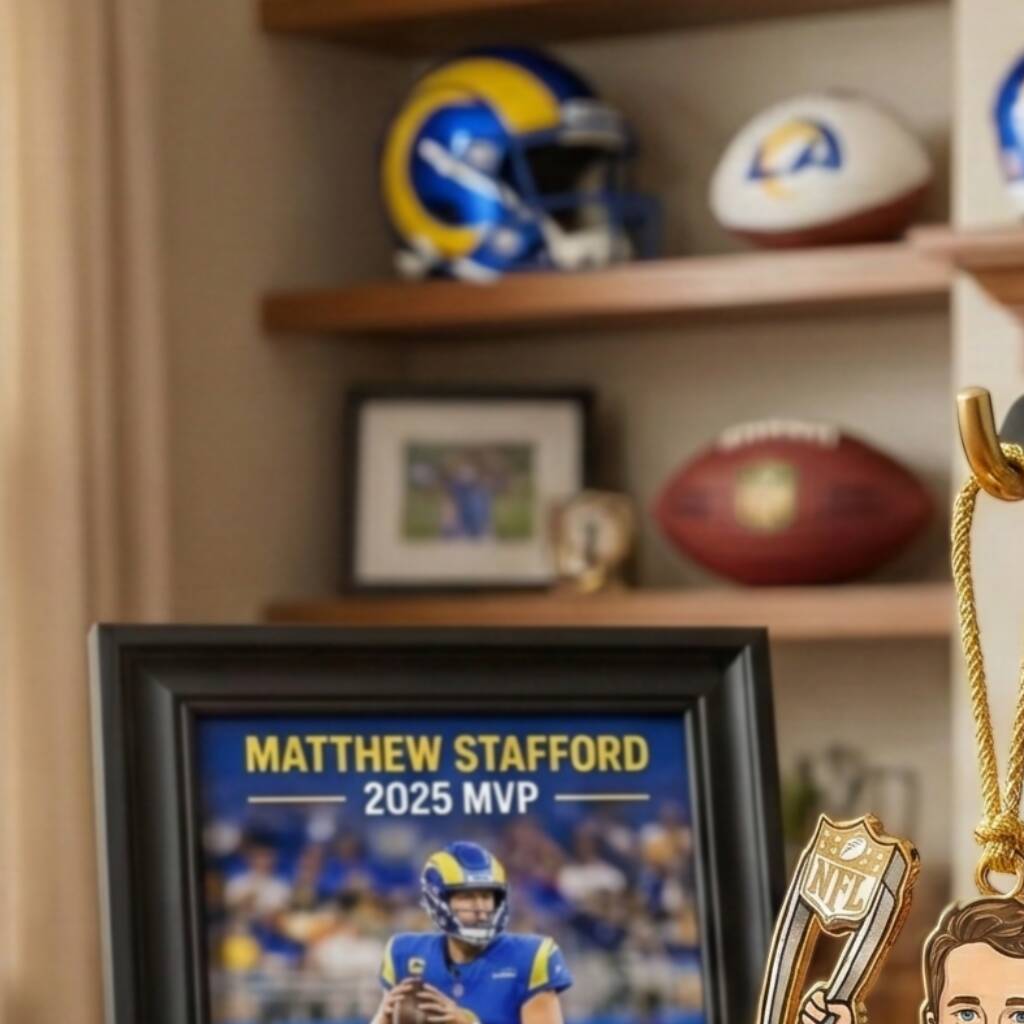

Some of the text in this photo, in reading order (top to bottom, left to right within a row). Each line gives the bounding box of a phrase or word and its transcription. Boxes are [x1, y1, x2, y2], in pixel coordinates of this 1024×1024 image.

[245, 735, 650, 773] MATTHEW STAFFORD
[364, 781, 539, 815] 2025 MVP
[807, 857, 866, 912] NFL
